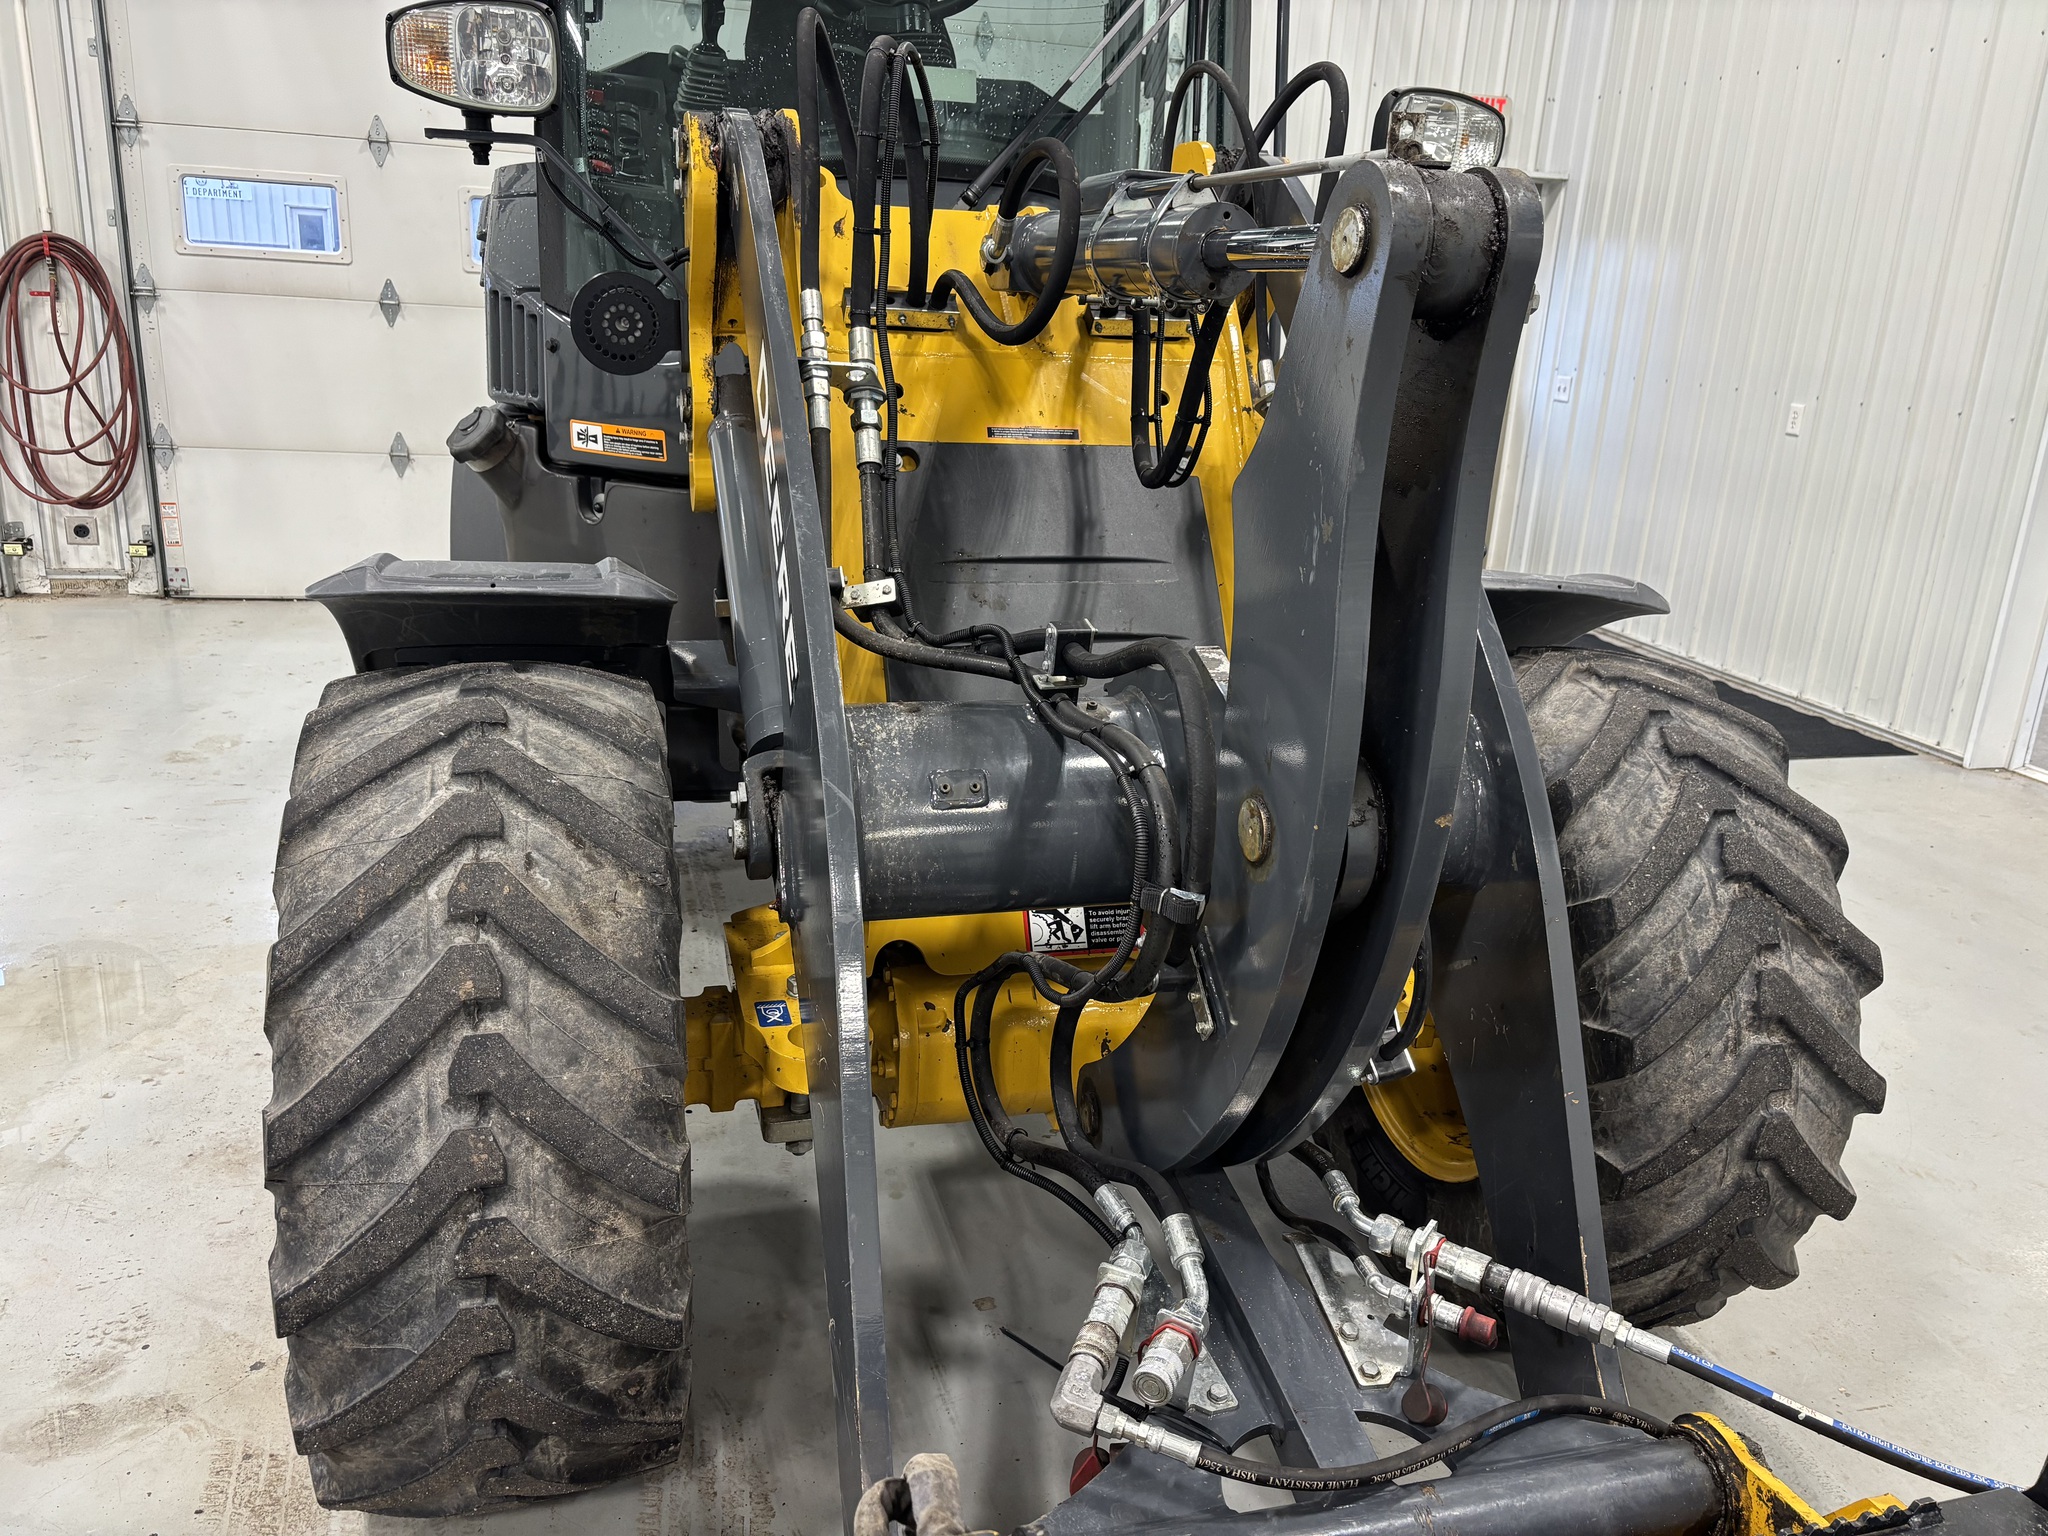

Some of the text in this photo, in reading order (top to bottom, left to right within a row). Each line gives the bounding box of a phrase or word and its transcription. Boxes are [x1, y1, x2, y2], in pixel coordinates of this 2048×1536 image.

[1473, 96, 1506, 113] IT
[192, 187, 242, 198] DEPARTMENT
[621, 427, 647, 437] WARNING
[756, 338, 799, 707] DEERE
[1115, 908, 1130, 916] injur
[1090, 929, 1127, 937] disassembl
[1588, 1406, 1603, 1416] CSI
[1870, 1435, 1890, 1447] HIGH
[1224, 1465, 1259, 1483] MSHA
[1266, 1475, 1325, 1490] RESISTANT
[1327, 1478, 1360, 1490] FLAME
